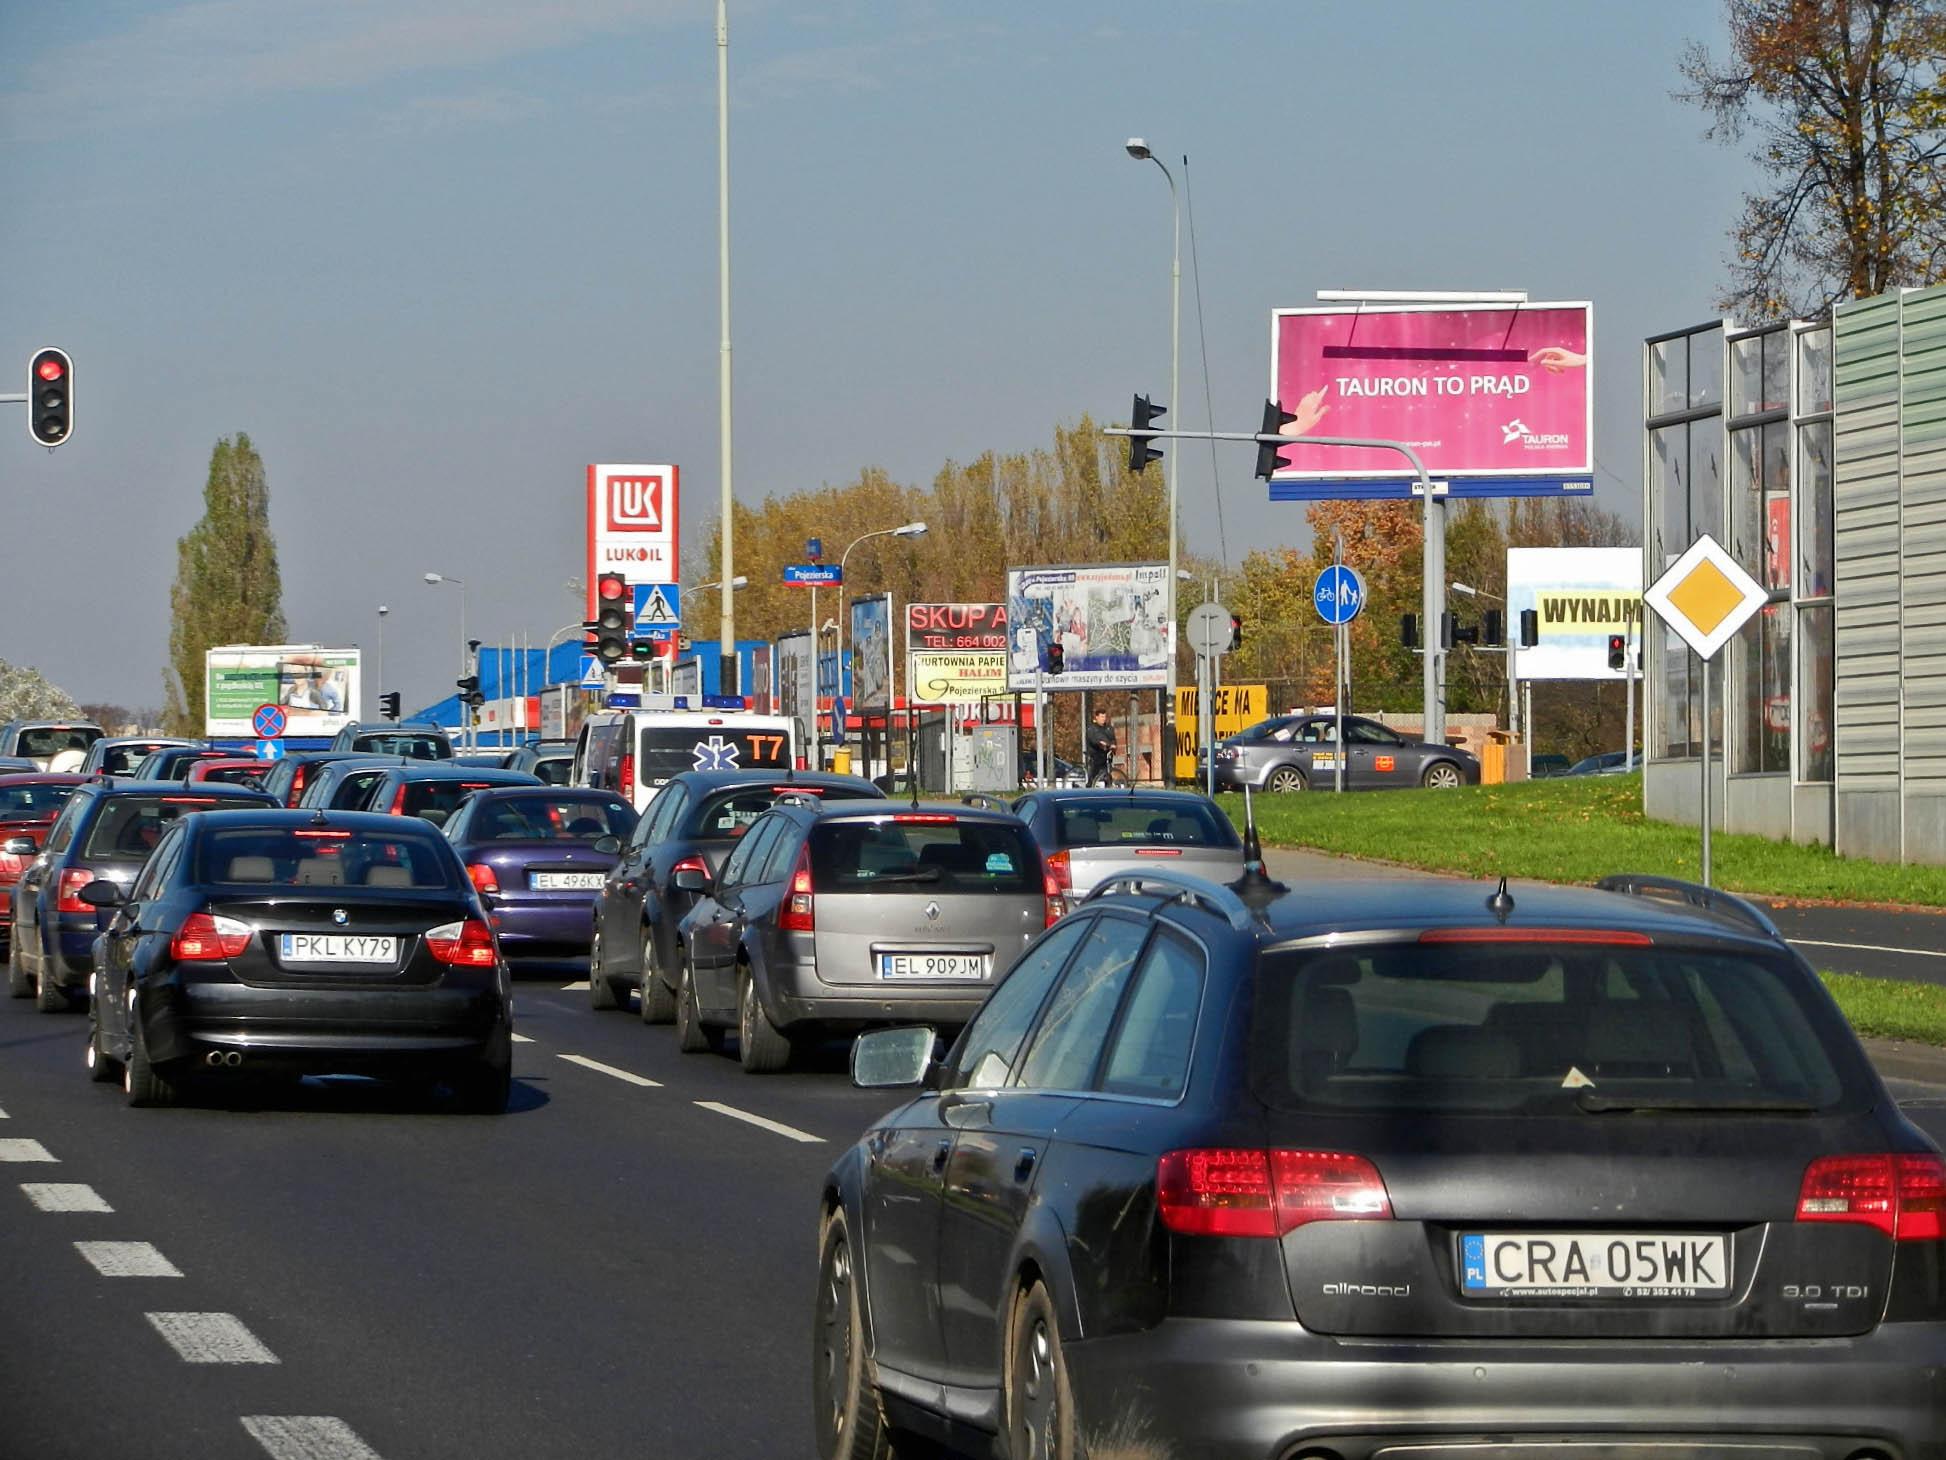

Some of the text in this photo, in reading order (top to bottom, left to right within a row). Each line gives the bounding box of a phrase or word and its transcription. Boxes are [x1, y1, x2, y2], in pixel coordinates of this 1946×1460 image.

[1336, 375, 1530, 398] TAURON TO PRĄD
[1522, 433, 1569, 444] TAURON
[606, 548, 663, 562] LUKOIL
[911, 606, 985, 629] SKUP
[924, 635, 1006, 648] TEL: 664 002
[747, 735, 784, 761] T7
[539, 875, 558, 887] EL
[295, 936, 337, 956] PKL
[343, 938, 392, 956] KY79
[895, 959, 918, 974] EL
[926, 958, 979, 974] 909JM
[1493, 1240, 1717, 1284] CRA 05WK
[1466, 1268, 1484, 1280] PL
[1322, 1282, 1411, 1297] allroad
[1783, 1284, 1868, 1299] 3.0 TDI
